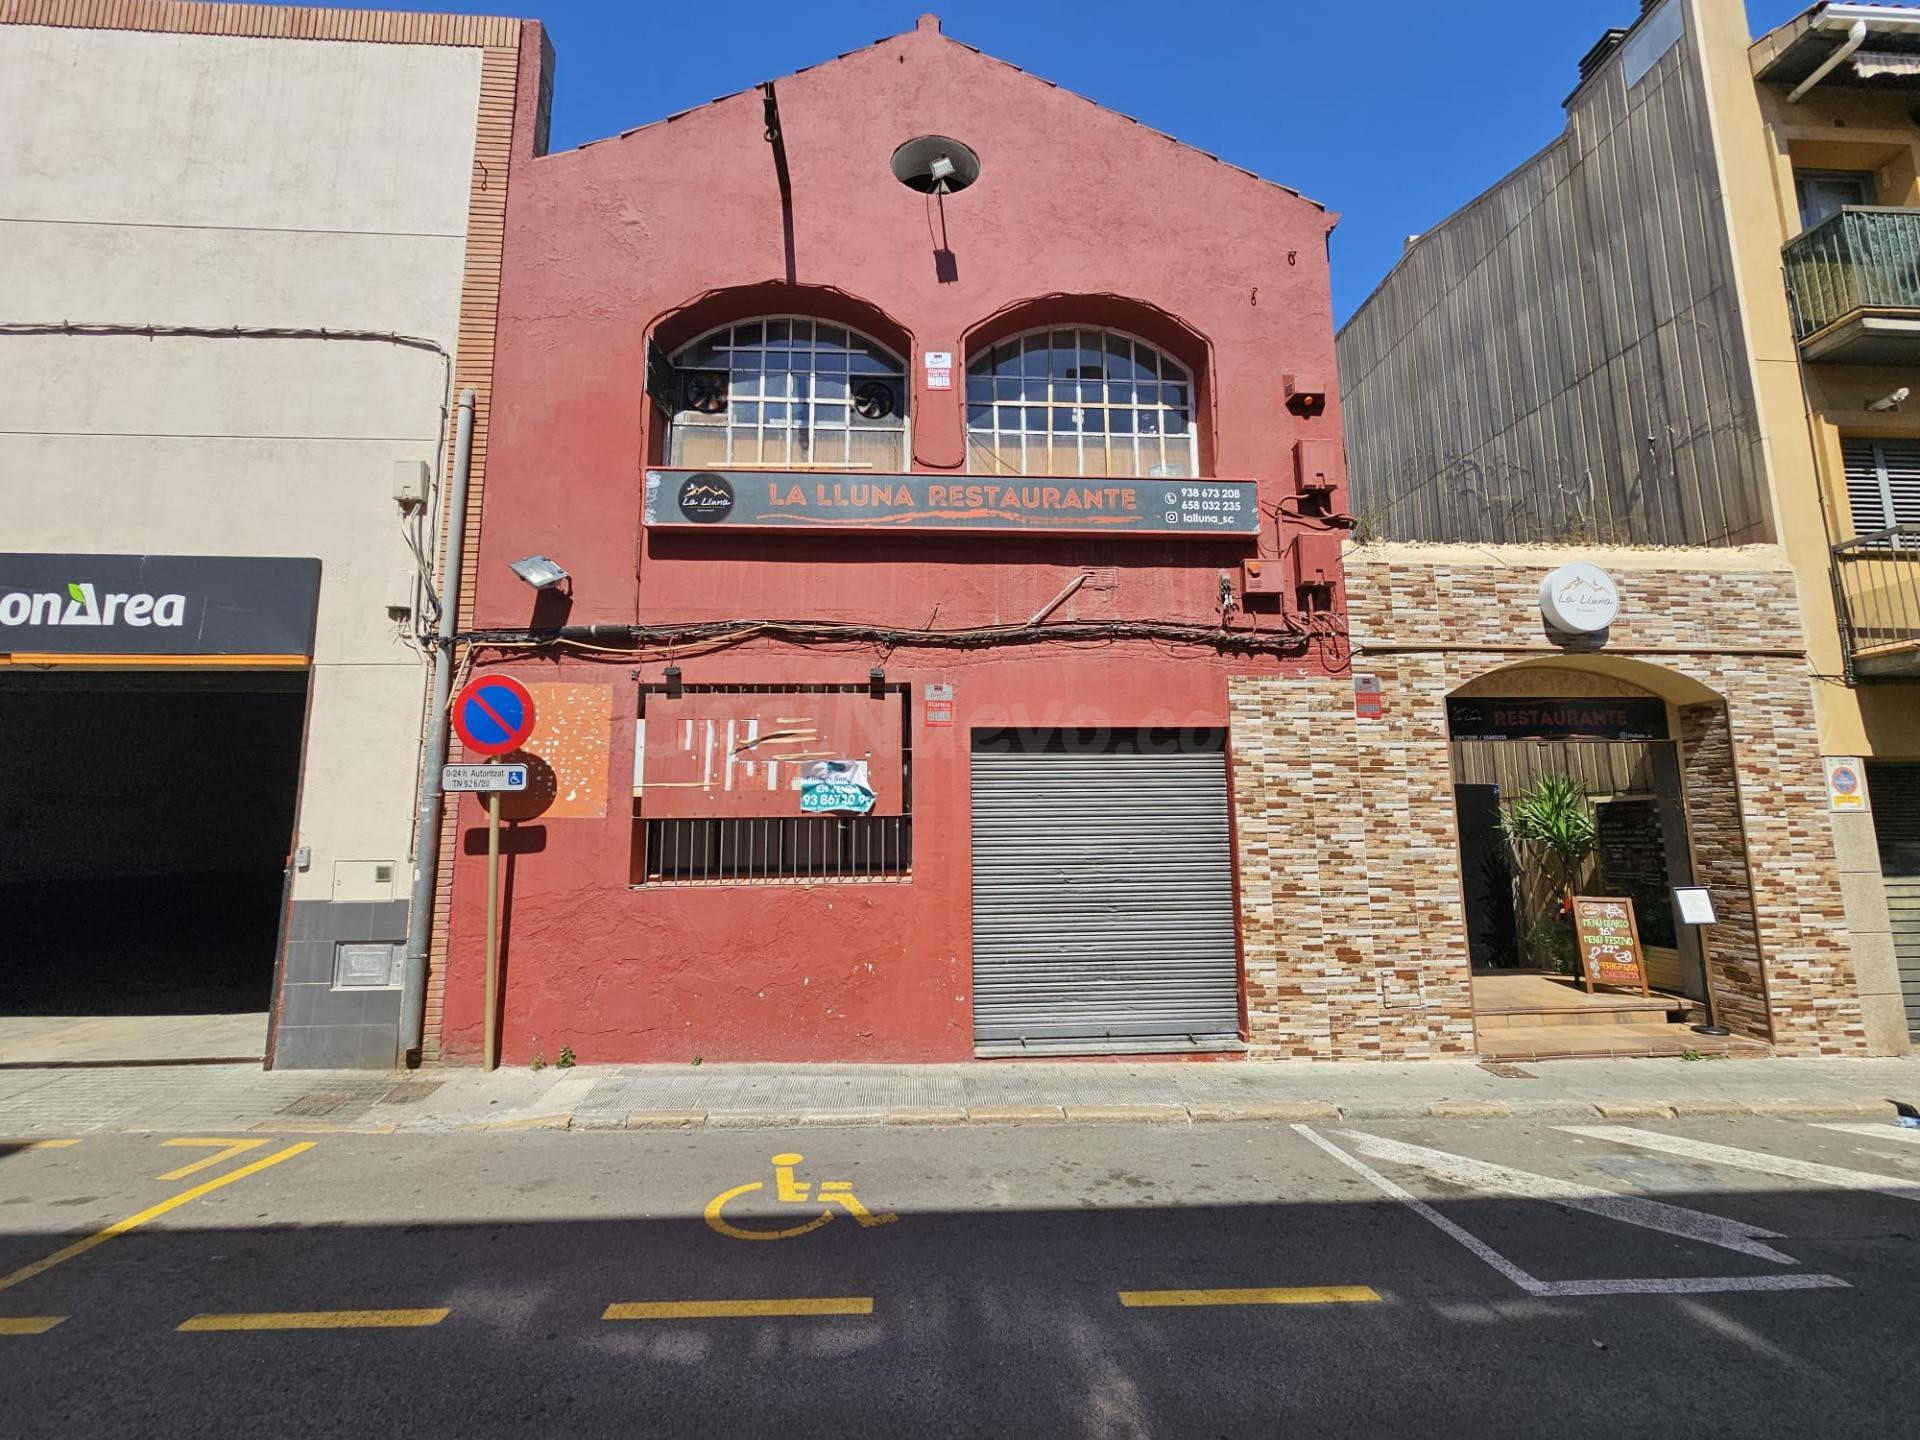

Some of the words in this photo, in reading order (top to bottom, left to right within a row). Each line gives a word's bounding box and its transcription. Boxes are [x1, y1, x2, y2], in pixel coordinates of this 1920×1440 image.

[768, 483, 806, 506] LA
[816, 483, 914, 507] LLUNA
[928, 484, 1136, 510] RESTAURANTE
[1181, 487, 1200, 498] 938
[1201, 488, 1220, 499] 673
[1222, 489, 1240, 499] 208
[682, 497, 698, 506] La
[701, 497, 732, 506] Lluna
[1181, 500, 1200, 510] 658
[1201, 501, 1220, 511] 032
[1222, 501, 1241, 511] 235
[1183, 513, 1235, 525] lalluna_sc
[1558, 592, 1576, 603] La
[1580, 593, 1615, 606] Lluna
[1493, 709, 1629, 727] RESTAURANTE
[445, 769, 461, 778] 0-24
[470, 769, 504, 778] Autoritzat
[452, 779, 463, 788] TN
[815, 784, 829, 793] EN
[803, 794, 818, 806] 93
[820, 794, 840, 806] 867
